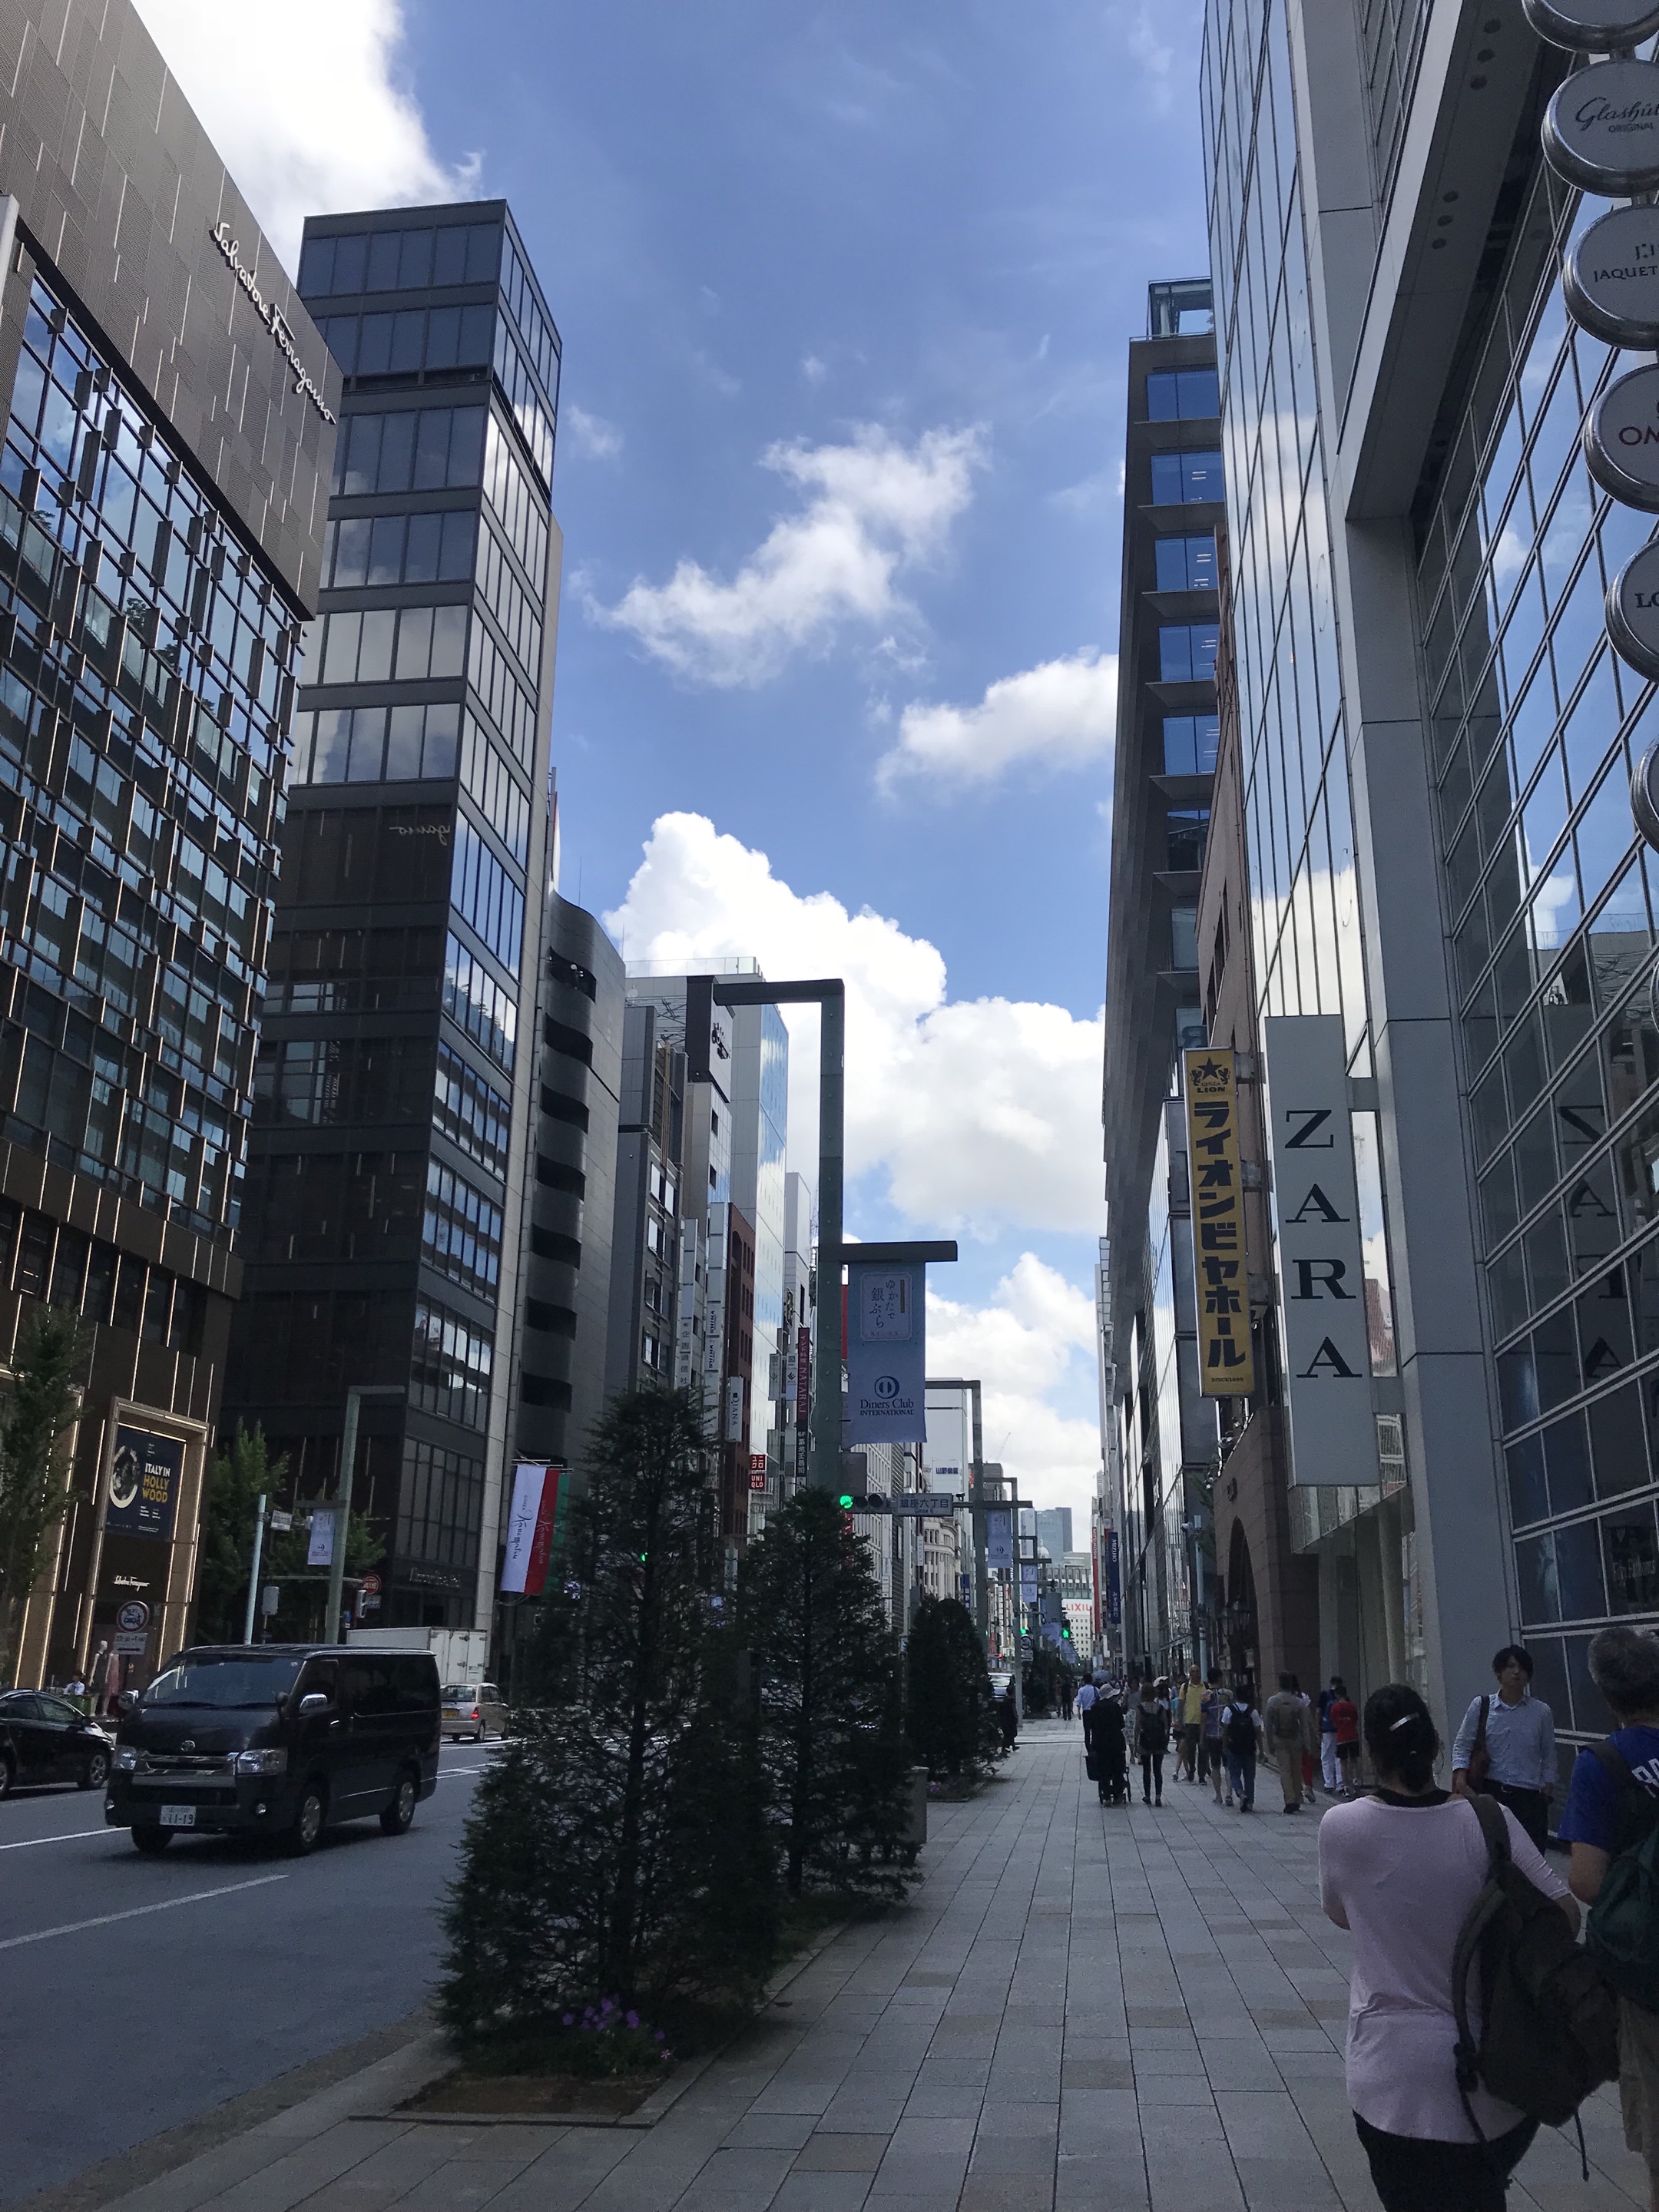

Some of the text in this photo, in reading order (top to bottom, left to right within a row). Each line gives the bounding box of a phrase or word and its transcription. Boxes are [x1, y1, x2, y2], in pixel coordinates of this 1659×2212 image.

[1594, 265, 1658, 283] JAQUET
[214, 222, 336, 425] Salvatore Ferragamo
[1194, 1101, 1246, 1369] ライオンビヤホール
[1284, 1109, 1363, 1379] ZARA
[869, 1287, 885, 1329] 銀ぶら
[799, 1367, 807, 1413] NATARAJ
[860, 1398, 914, 1409] Diners Club
[144, 1462, 171, 1477] ITALY IN
[143, 1475, 170, 1491] HOLLY
[142, 1488, 168, 1503] WOOD
[899, 1498, 949, 1508] 銀座六丁目
[1066, 1603, 1091, 1611] LIXIL
